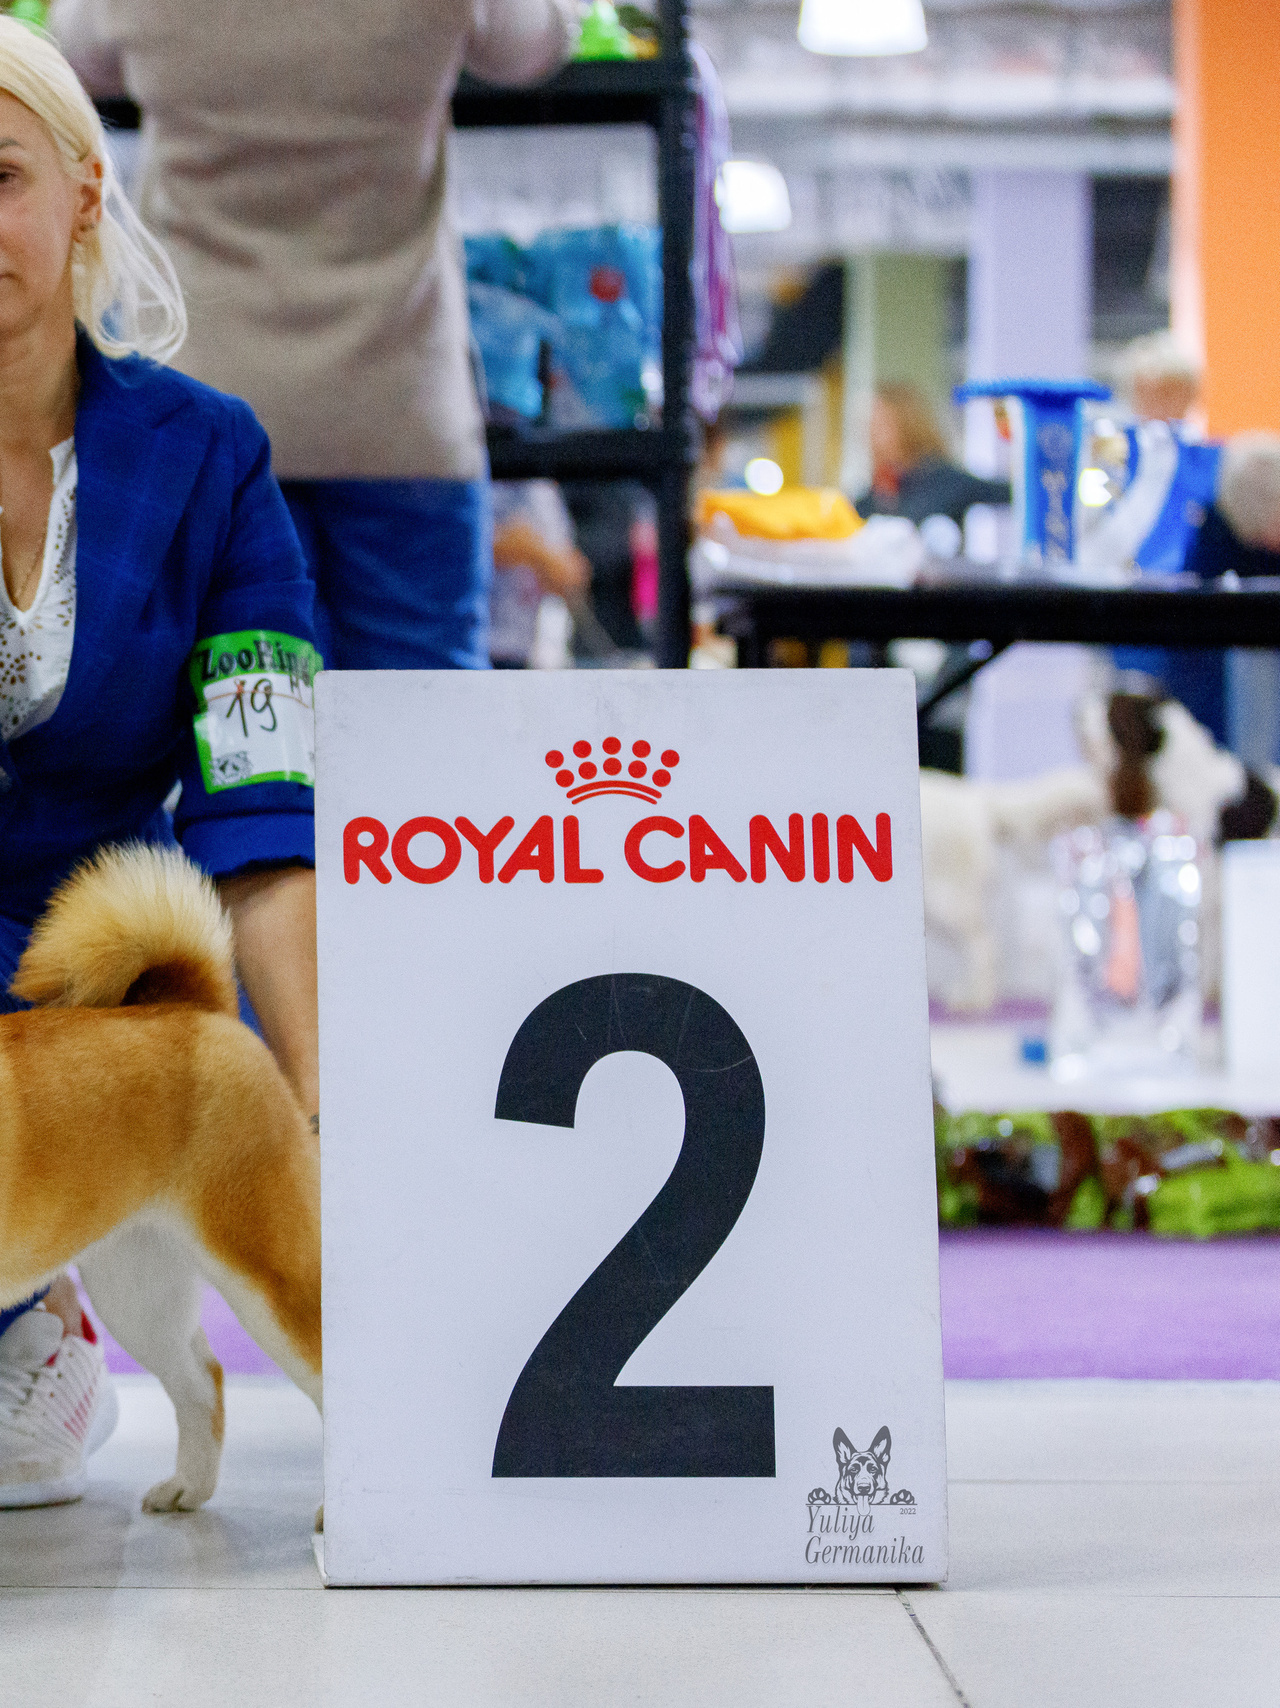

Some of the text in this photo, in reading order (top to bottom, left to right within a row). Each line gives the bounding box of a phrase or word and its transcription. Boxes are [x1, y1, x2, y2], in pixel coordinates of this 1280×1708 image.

[225, 677, 278, 738] 19
[343, 812, 893, 885] ROYAL CANIN
[492, 973, 776, 1478] 2
